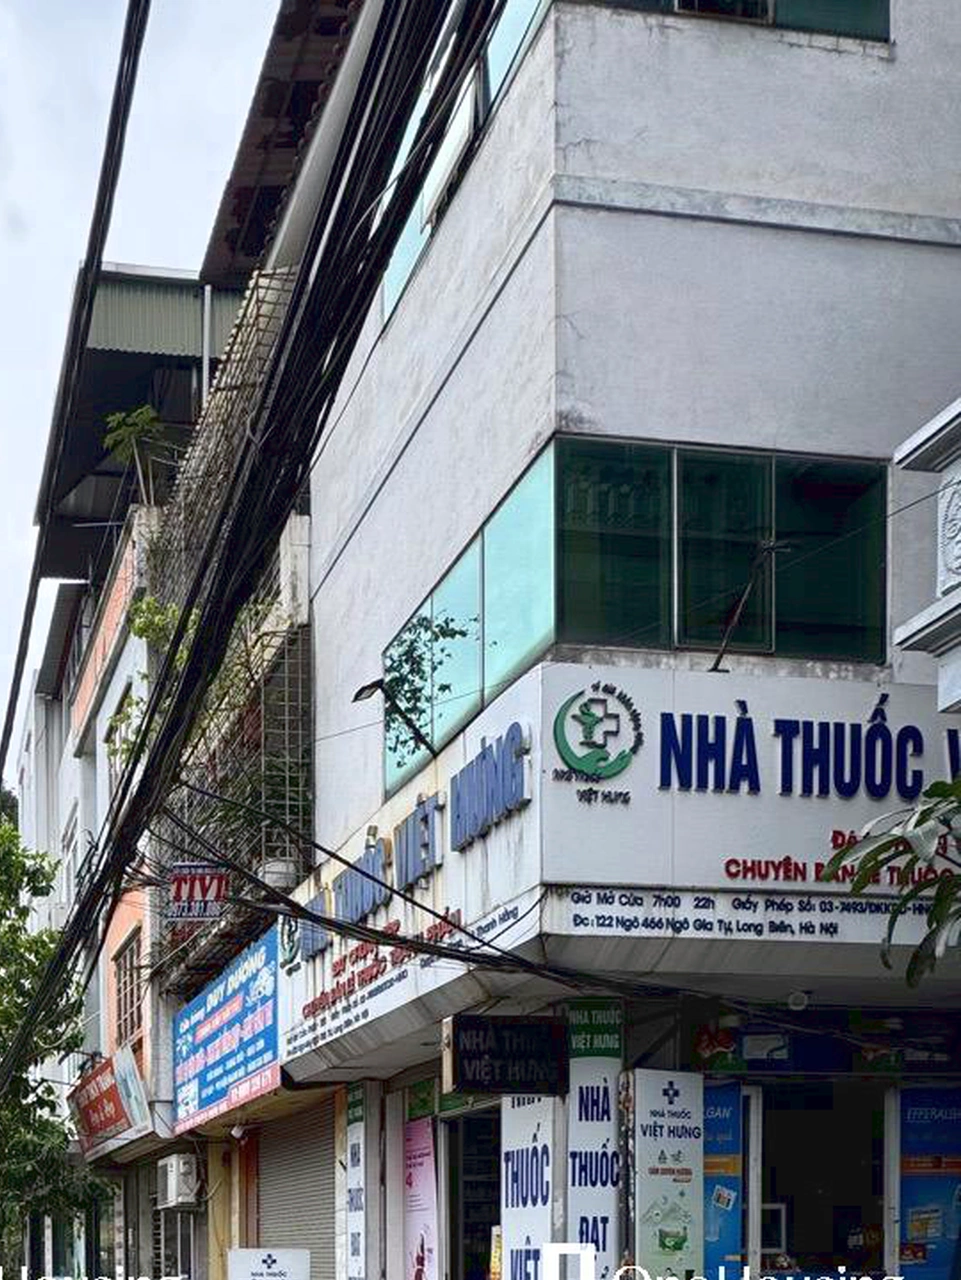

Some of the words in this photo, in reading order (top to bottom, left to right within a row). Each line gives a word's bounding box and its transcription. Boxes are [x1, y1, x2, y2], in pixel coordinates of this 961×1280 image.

[657, 700, 762, 797] NHÀ
[773, 692, 925, 800] THUỐC
[724, 855, 807, 882] CHUYÊN
[169, 872, 229, 903] TIVI
[652, 894, 681, 909] 7h00
[693, 895, 716, 910] 22h
[764, 896, 794, 914] Phép
[641, 916, 664, 931] 466
[693, 917, 714, 933] Gia
[736, 918, 764, 937] Long
[798, 919, 815, 934] Hà
[820, 920, 839, 938] Nội
[578, 1077, 611, 1122] NHÀ
[640, 1120, 664, 1142] VIỆT
[503, 1121, 550, 1209] THUỐC
[569, 1137, 620, 1188] THUỐC
